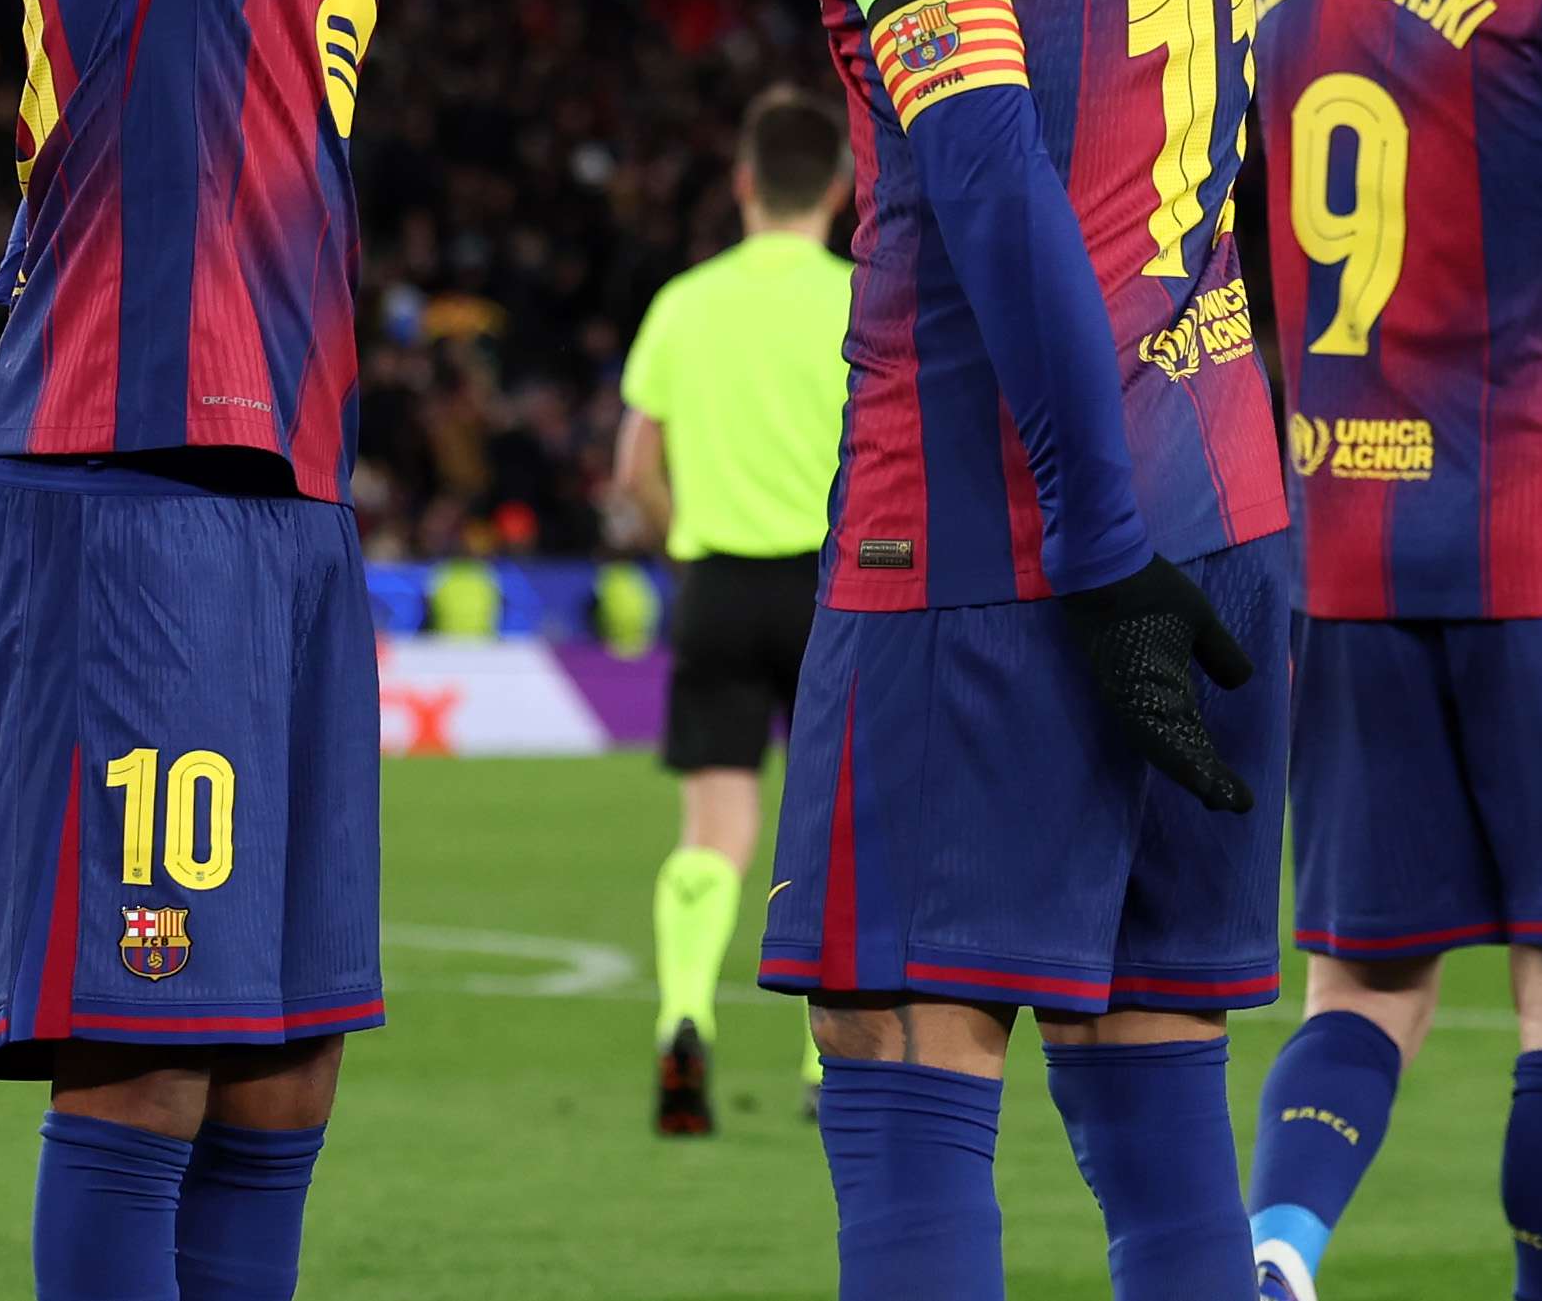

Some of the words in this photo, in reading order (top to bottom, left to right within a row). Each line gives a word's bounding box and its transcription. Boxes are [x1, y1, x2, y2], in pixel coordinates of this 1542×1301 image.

[1291, 72, 1409, 356] 9
[1334, 417, 1434, 445] UNHCR
[1330, 443, 1435, 470] ACNUR
[106, 748, 235, 890] 10
[141, 936, 170, 948] FCB
